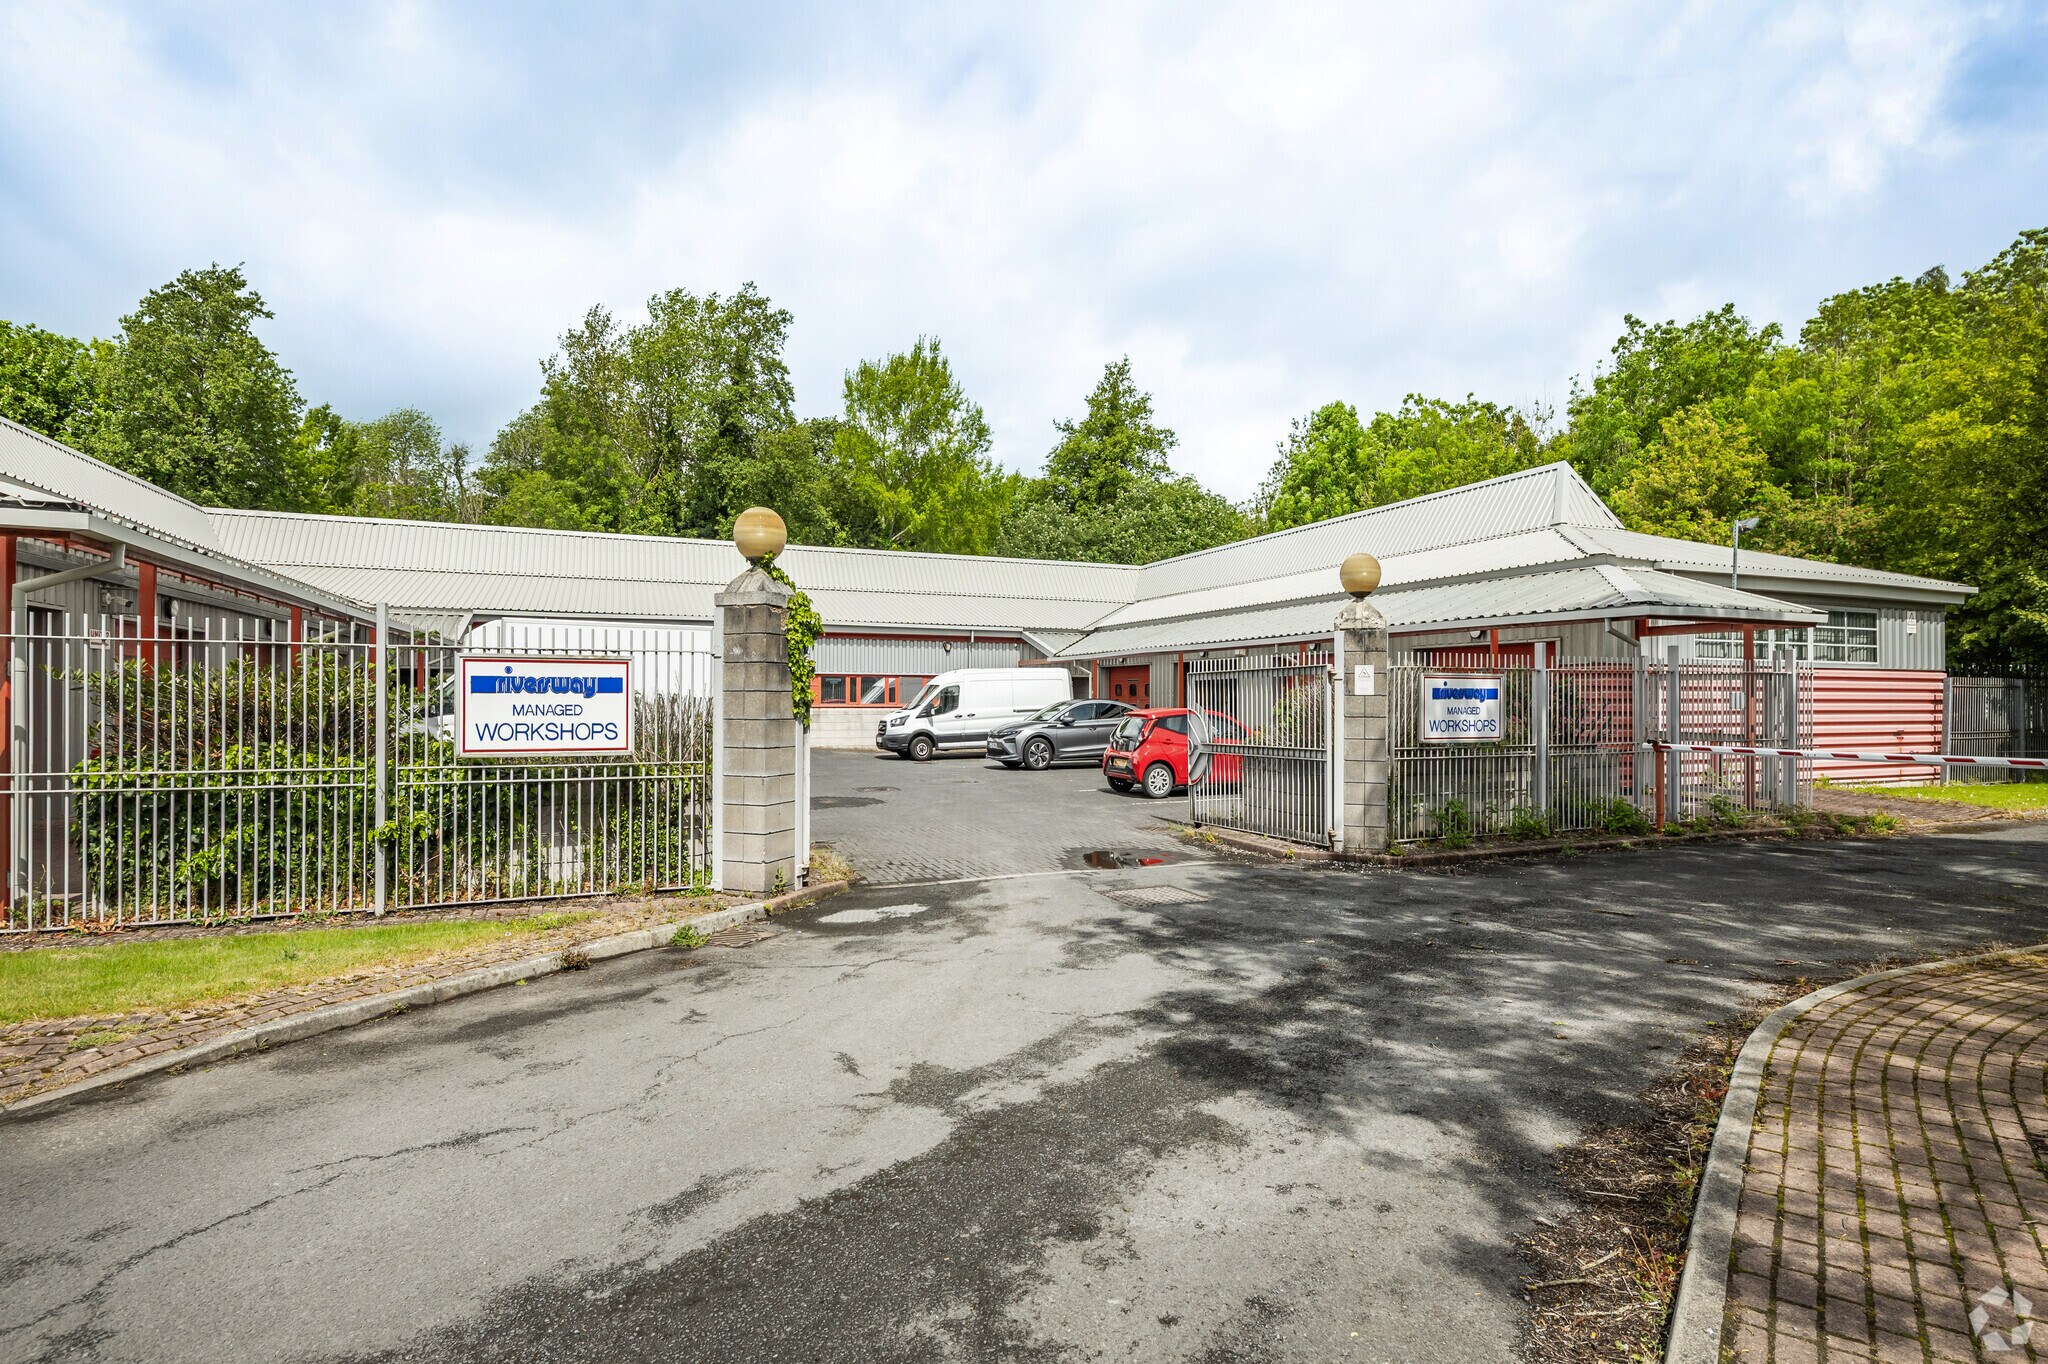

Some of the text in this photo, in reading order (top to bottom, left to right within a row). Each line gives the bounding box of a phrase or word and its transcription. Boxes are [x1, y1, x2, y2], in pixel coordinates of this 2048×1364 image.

[495, 665, 599, 699] riversway
[512, 704, 583, 717] MANAGED
[1446, 706, 1481, 715] MANAGED
[475, 722, 618, 741] WORKSHOPS
[1429, 719, 1497, 732] WORKSHOPS
